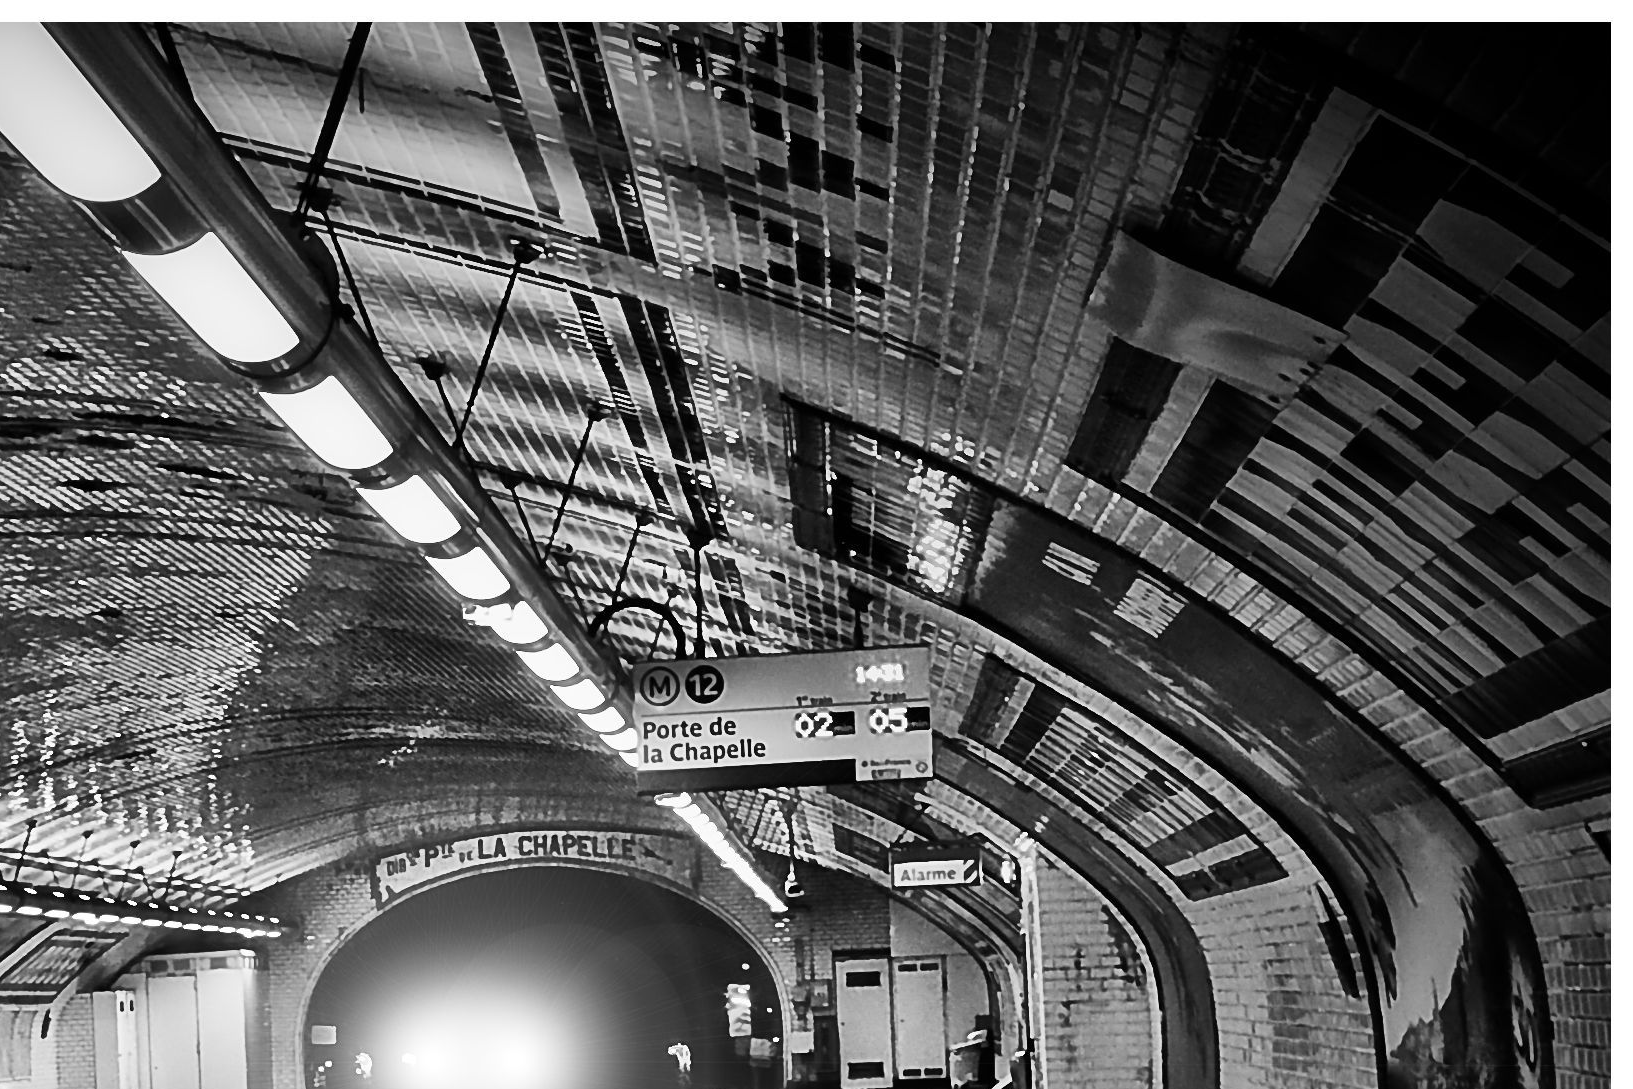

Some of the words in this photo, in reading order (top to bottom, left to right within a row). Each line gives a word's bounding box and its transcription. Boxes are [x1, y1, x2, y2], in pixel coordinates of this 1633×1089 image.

[688, 674, 718, 696] 12
[643, 720, 703, 740] Porte
[709, 716, 736, 736] de
[795, 711, 834, 738] 02
[869, 707, 908, 734] 05
[643, 744, 663, 763] la
[670, 739, 766, 764] Chapelle
[478, 837, 507, 860] LA
[518, 833, 637, 860] CHAPELLE
[900, 868, 957, 881] Alarme
